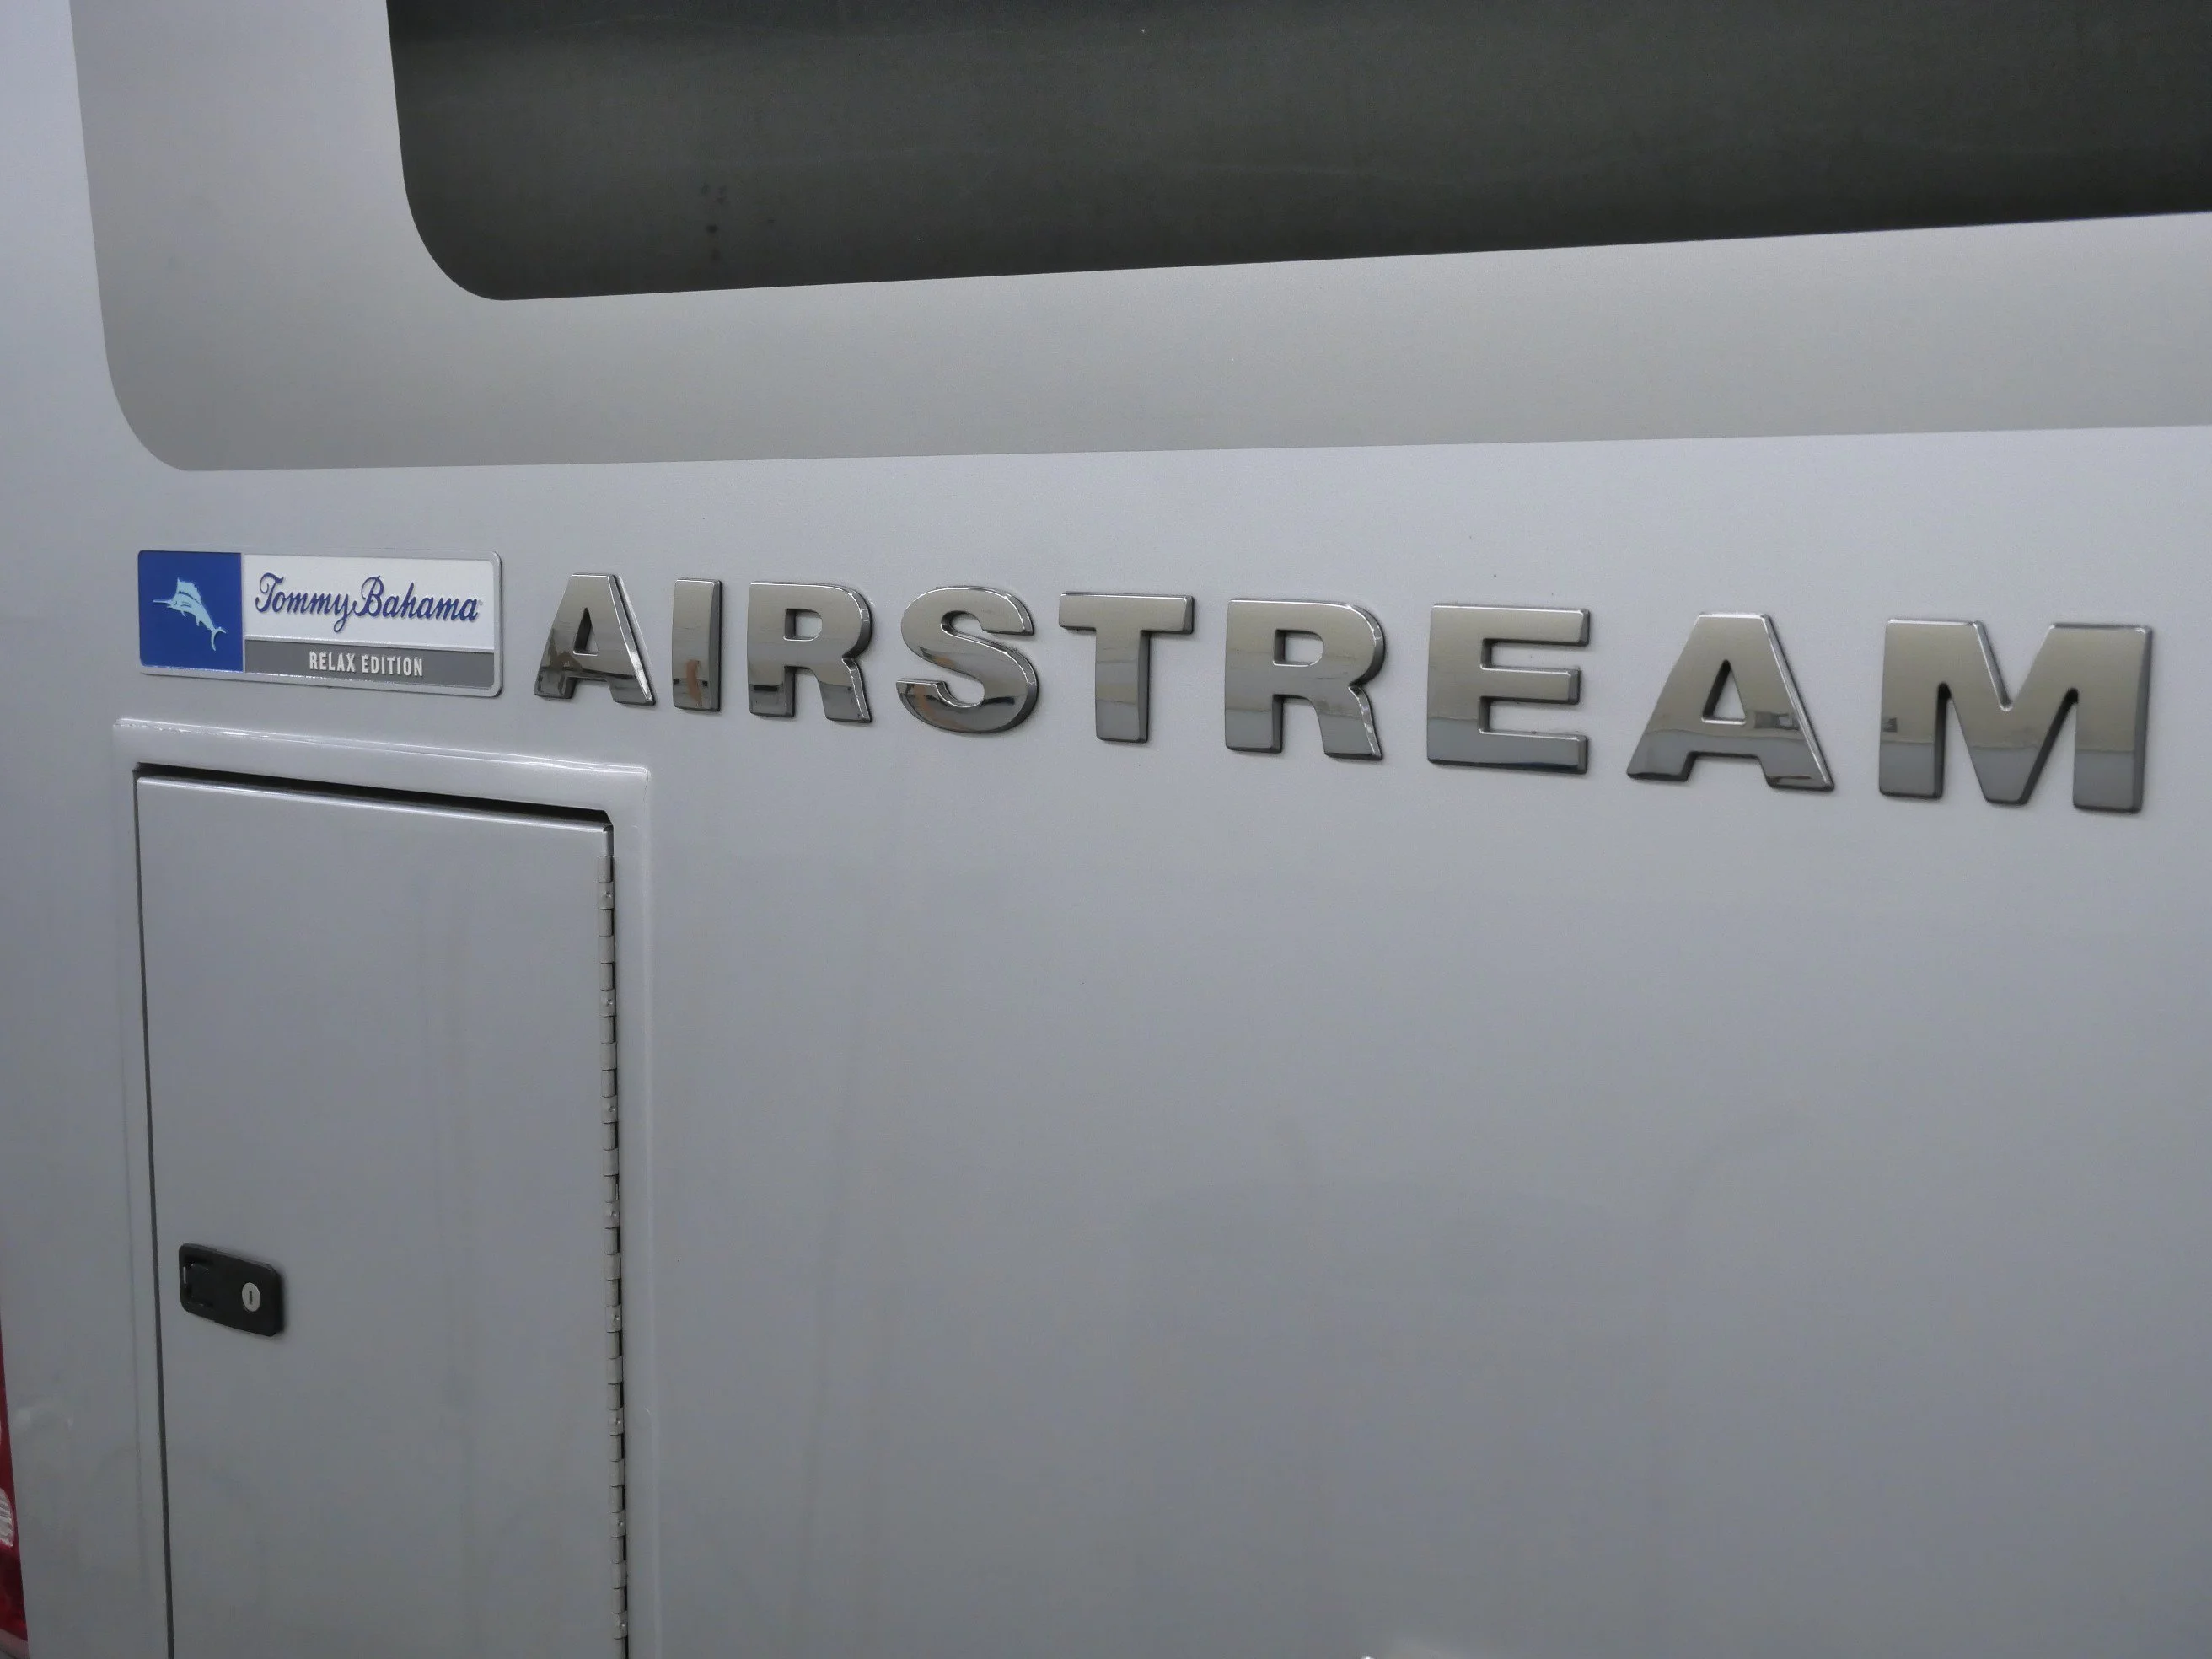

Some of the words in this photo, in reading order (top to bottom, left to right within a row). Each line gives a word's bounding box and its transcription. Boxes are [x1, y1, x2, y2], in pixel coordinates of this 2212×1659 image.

[255, 572, 355, 632] Tommy
[354, 575, 479, 621] Bahama
[309, 651, 356, 673] RELAX
[362, 654, 423, 677] EDITION
[534, 572, 2153, 813] AIRSTREAM
